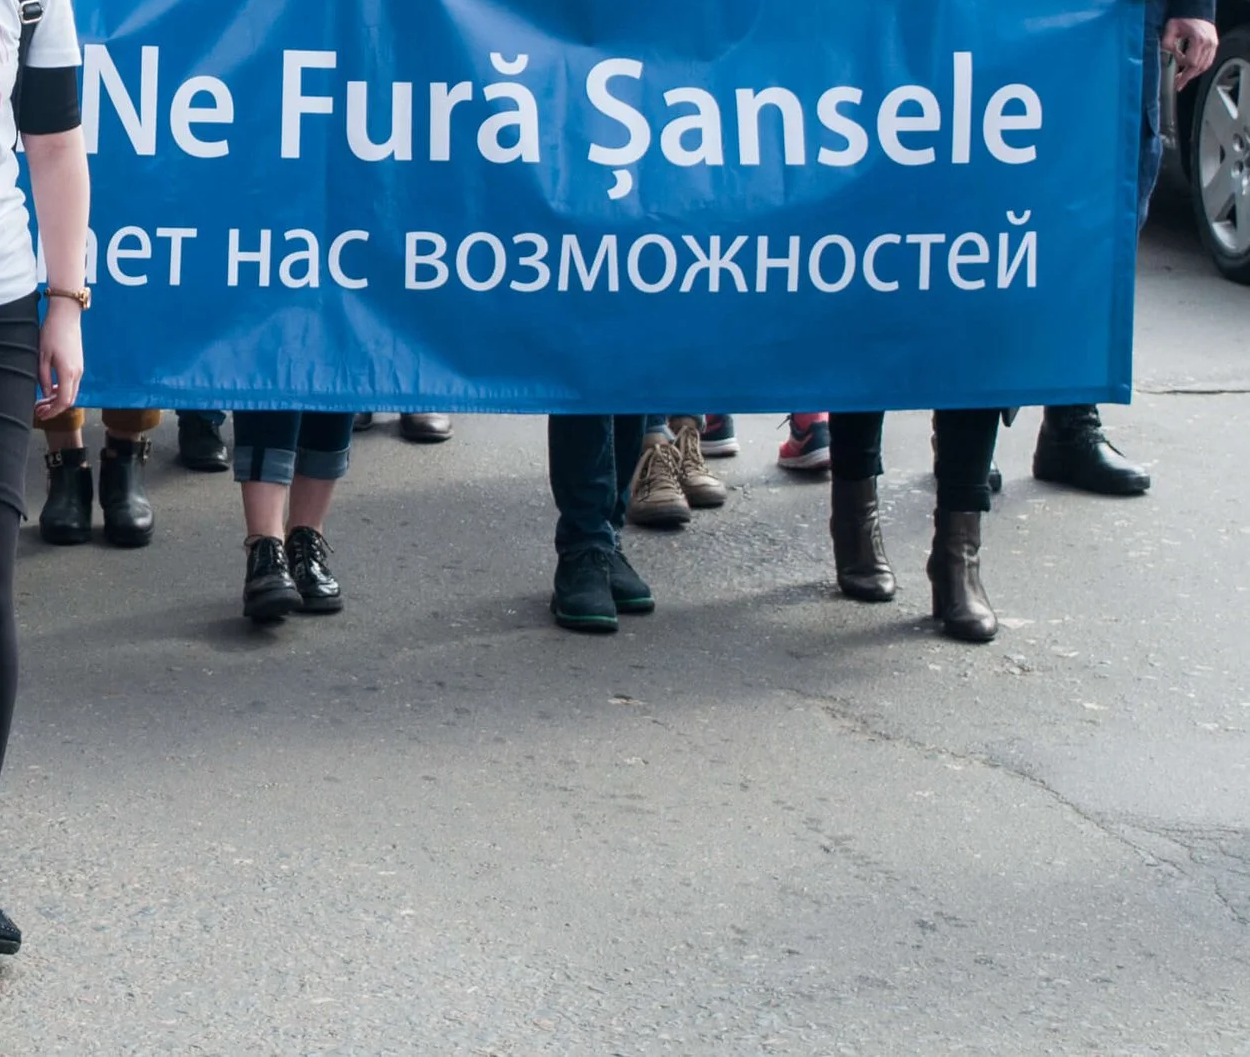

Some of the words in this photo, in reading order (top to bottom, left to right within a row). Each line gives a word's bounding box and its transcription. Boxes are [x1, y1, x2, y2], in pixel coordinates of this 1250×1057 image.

[80, 44, 235, 160] Ne
[281, 49, 542, 164] Fură
[586, 51, 1043, 200] Șansele
[228, 228, 370, 290] нас
[404, 210, 1039, 293] возможностей
